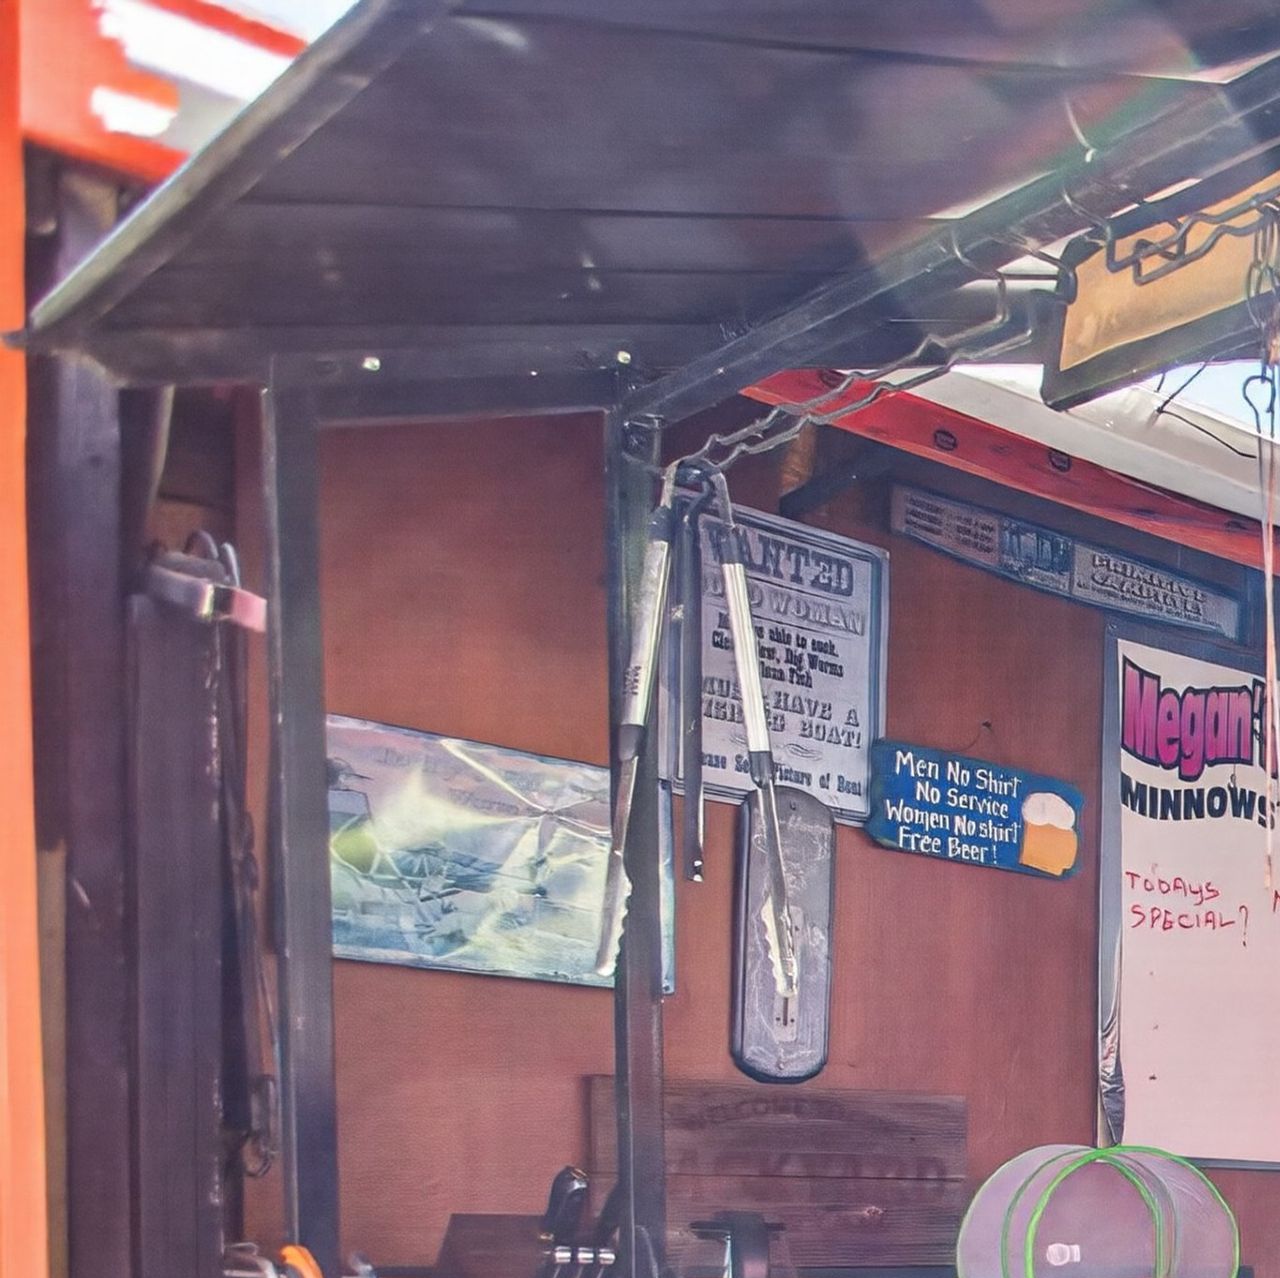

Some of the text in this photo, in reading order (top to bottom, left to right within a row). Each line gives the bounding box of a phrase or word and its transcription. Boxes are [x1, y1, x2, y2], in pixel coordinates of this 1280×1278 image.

[770, 590, 865, 637] WOMAN
[760, 661, 786, 681] lean
[773, 691, 833, 721] HAVE
[844, 708, 860, 728] A
[799, 720, 861, 749] BOAT!
[895, 750, 1022, 798] Men No Shirt
[916, 781, 1009, 819] No Service
[1121, 773, 1276, 831] MINNOWS
[886, 799, 1022, 844] Women No shirt
[899, 826, 941, 854] Free
[1125, 871, 1220, 906] TODAYS
